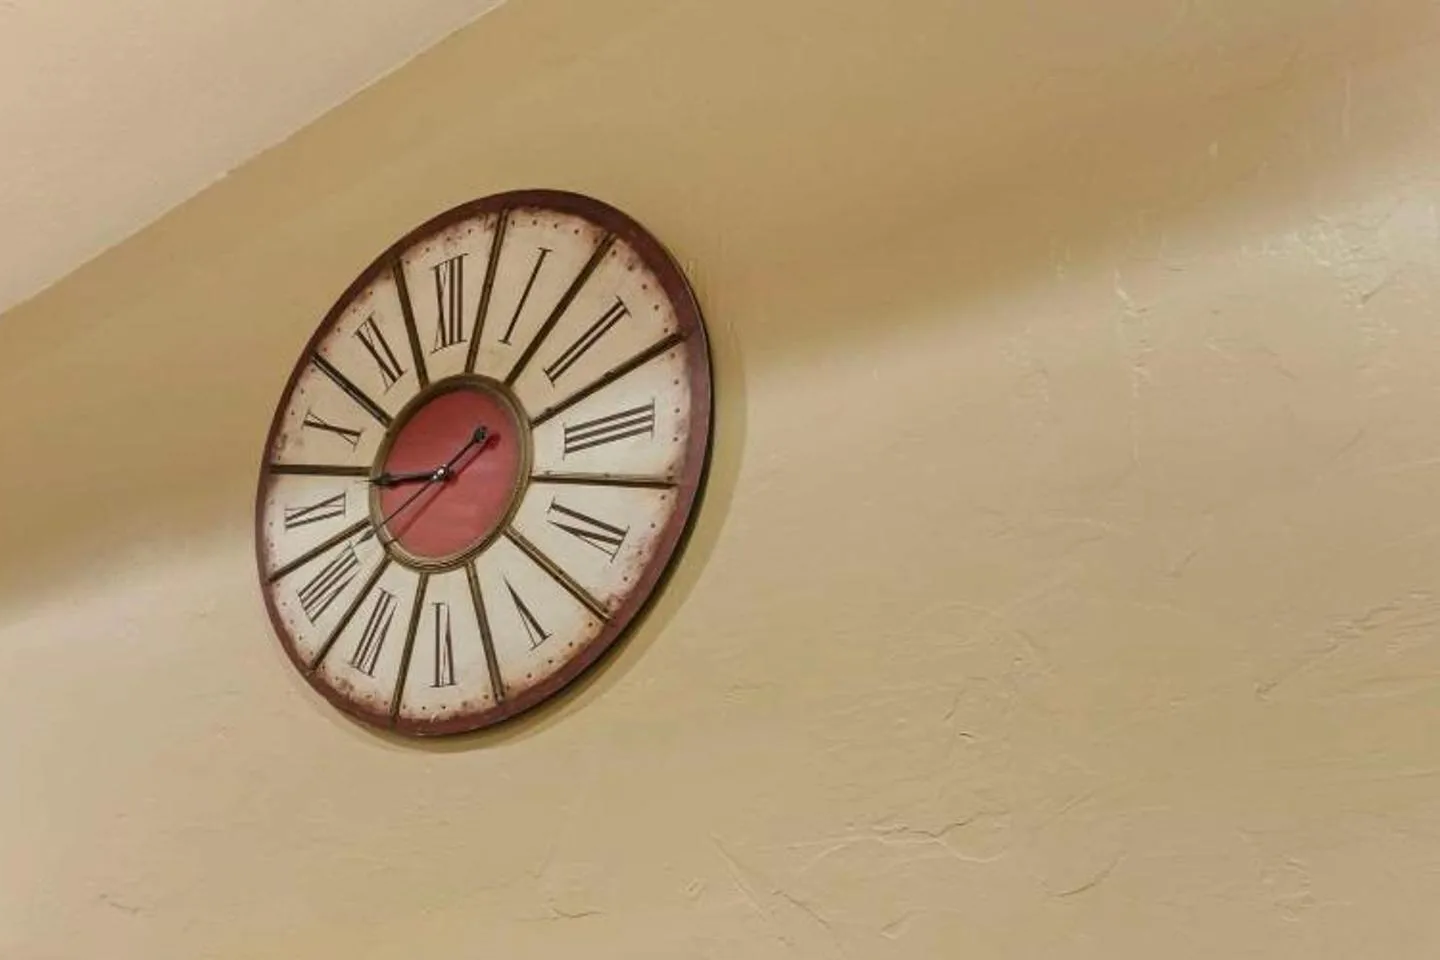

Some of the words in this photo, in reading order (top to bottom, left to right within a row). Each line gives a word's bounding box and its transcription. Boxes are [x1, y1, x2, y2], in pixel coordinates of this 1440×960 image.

[430, 252, 469, 354] XII
[497, 246, 553, 346] I
[351, 310, 408, 396] XI
[542, 295, 632, 388] II
[301, 408, 363, 451] X
[562, 397, 655, 461] III
[284, 490, 346, 530] IX
[546, 497, 630, 563] IV
[348, 586, 398, 679] VII
[429, 601, 458, 688] VI
[502, 573, 553, 651] V
